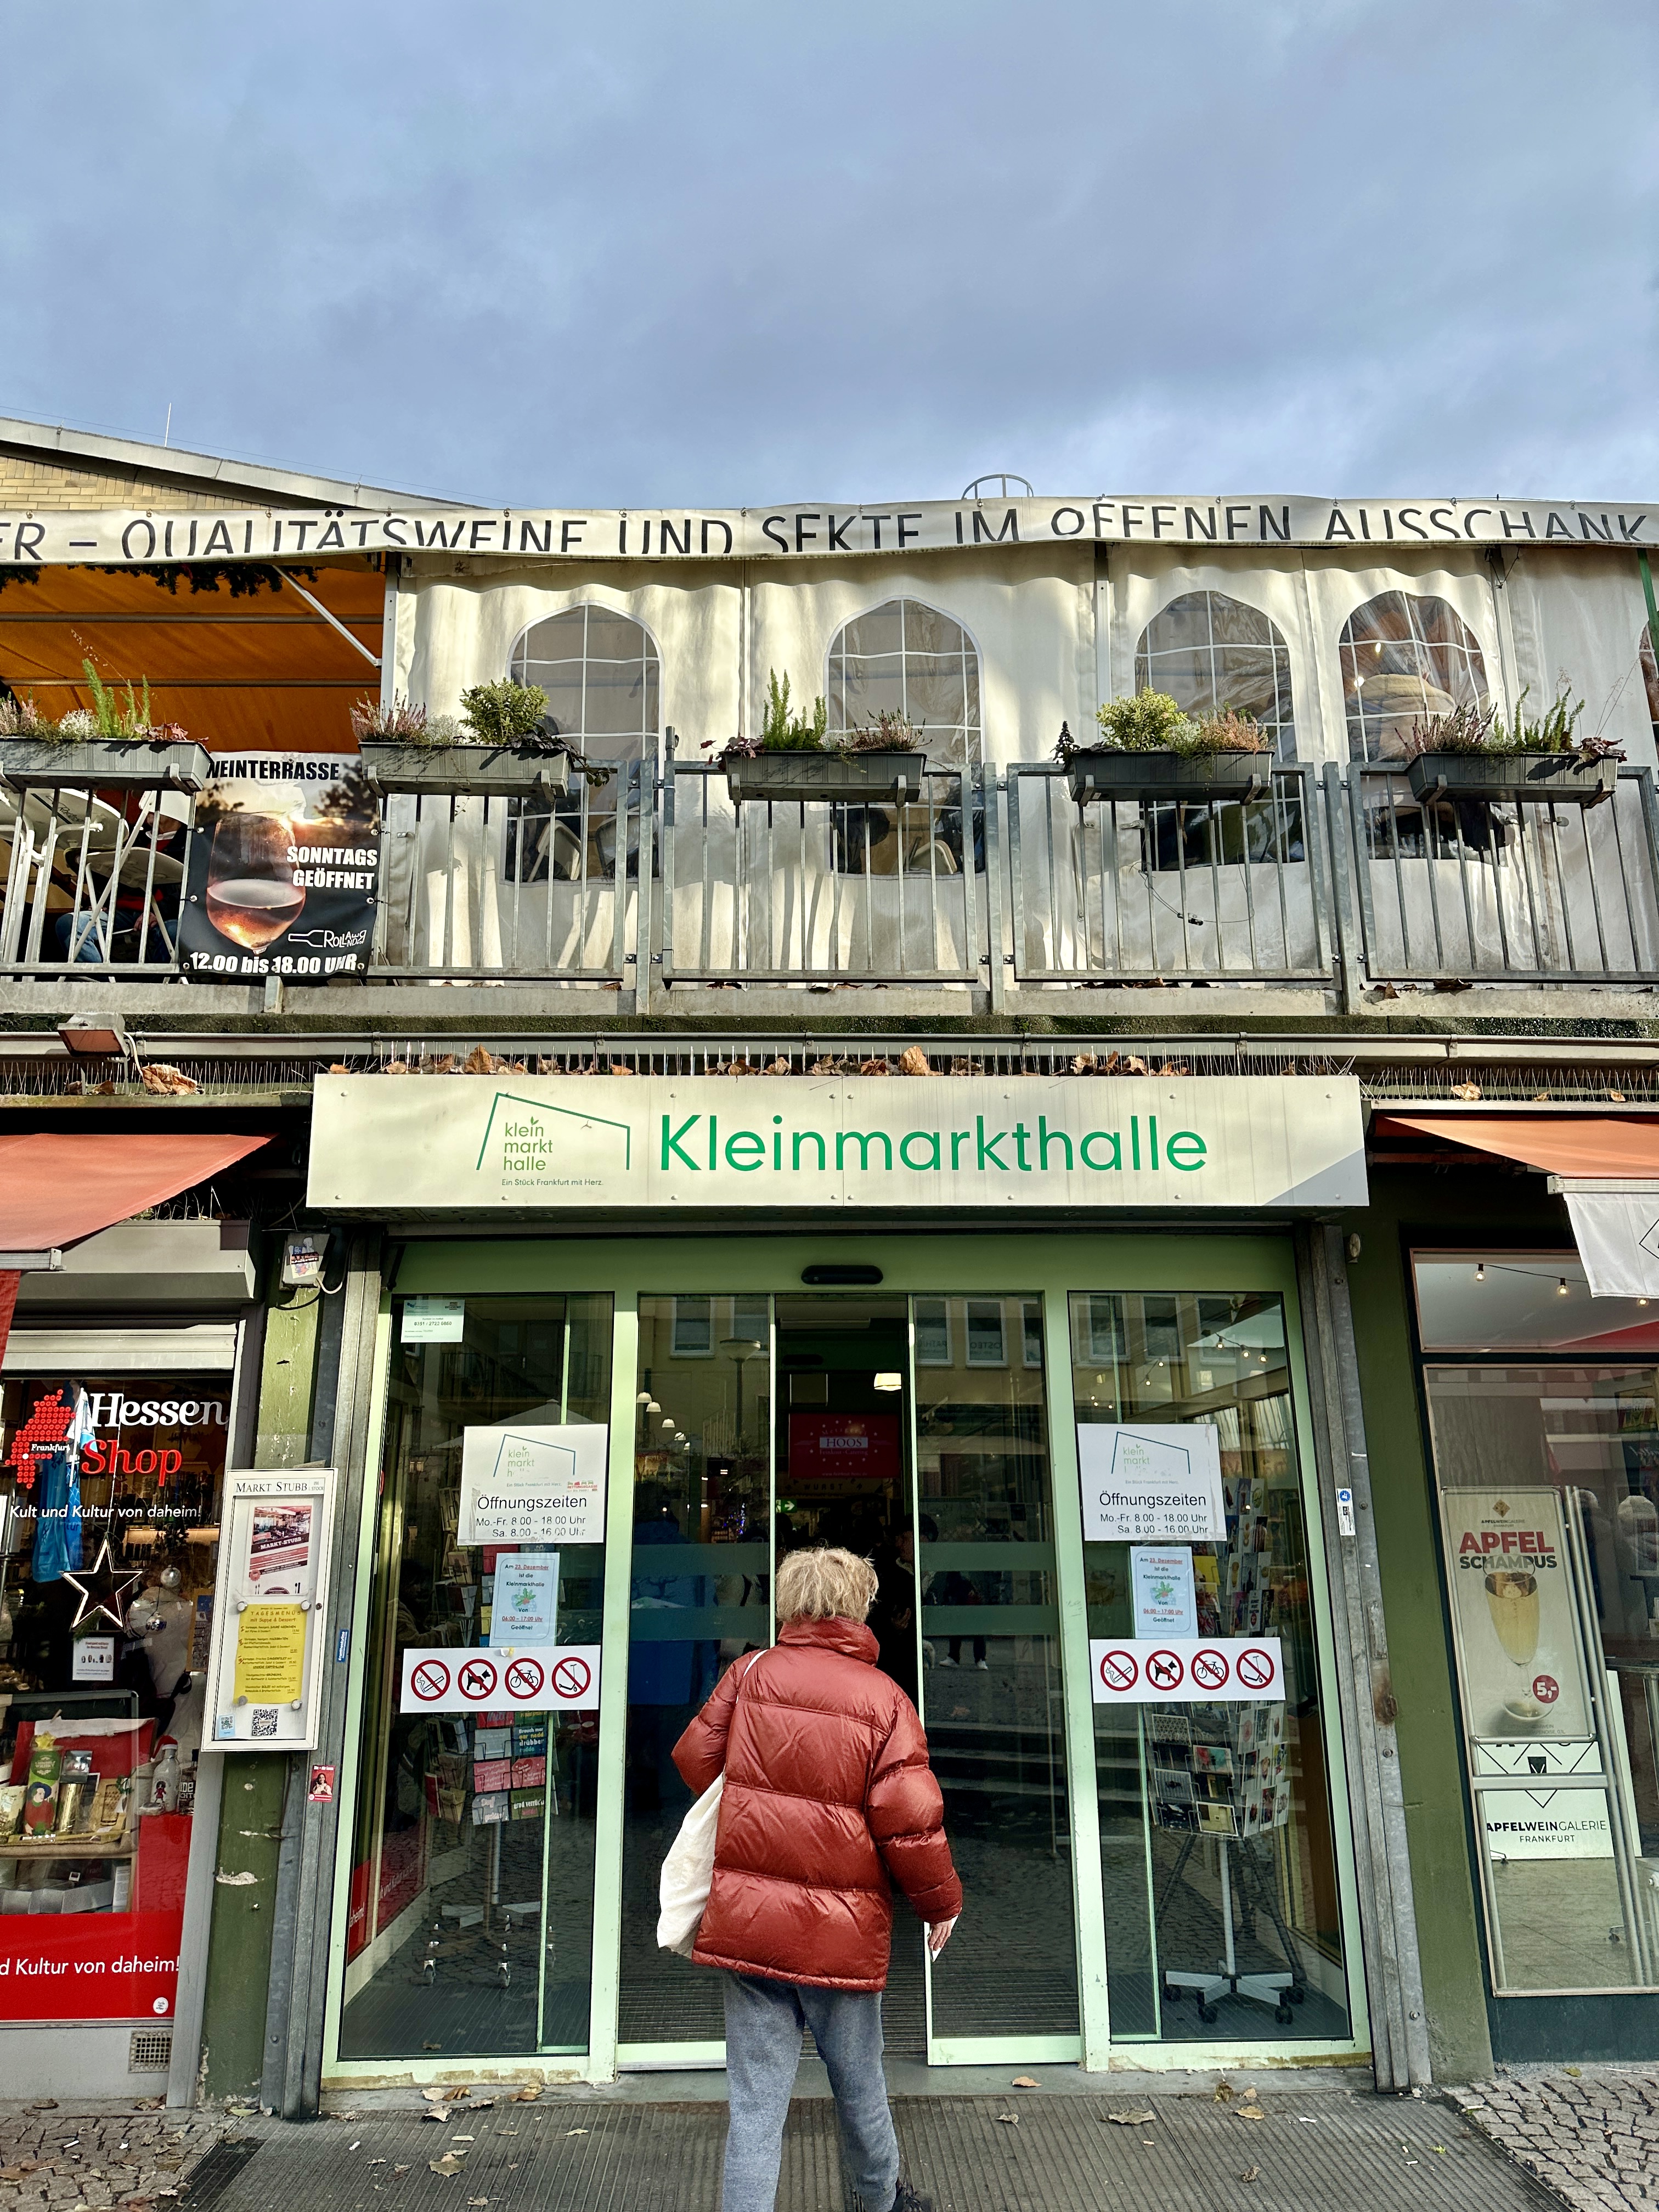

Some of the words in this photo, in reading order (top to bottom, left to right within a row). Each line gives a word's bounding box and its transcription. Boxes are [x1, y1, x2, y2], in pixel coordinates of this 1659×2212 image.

[955, 508, 1020, 544] IM
[286, 845, 378, 867] SONNTAGS
[292, 867, 374, 890] GEÖFFNET
[190, 952, 240, 973] 12.00
[241, 956, 269, 974] bis
[272, 956, 323, 974] 18.00
[325, 953, 357, 974] UHR
[505, 1122, 544, 1137] klein
[504, 1139, 552, 1153] markt
[661, 1114, 1207, 1171] Kleinmarkthalle
[504, 1156, 546, 1171] halle
[90, 1393, 229, 1429] Hessen
[31, 1443, 70, 1452] Frankfurt
[826, 1438, 862, 1447] HOOS
[508, 1449, 530, 1458] klein
[1123, 1447, 1144, 1455] klein
[81, 1440, 182, 1487] Shop
[507, 1459, 535, 1467] markt
[1124, 1457, 1150, 1465] markt
[235, 1483, 272, 1493] MARKT
[276, 1481, 307, 1492] STUBB
[478, 1494, 587, 1511] Öffnungszeiten
[1099, 1490, 1206, 1509] Öffnungszeiten
[10, 1505, 38, 1518] Kult
[42, 1505, 69, 1518] und
[72, 1505, 115, 1517] Kultur
[118, 1509, 143, 1517] von
[147, 1505, 202, 1517] daheim!
[1101, 1514, 1132, 1522] Mo.-Fr.
[1135, 1514, 1154, 1522] 8.00
[1164, 1514, 1188, 1522] 18.00
[1191, 1514, 1207, 1522] Uhr
[476, 1517, 508, 1526] Mo.-Fr.
[569, 1516, 586, 1524] Uhr
[493, 1529, 507, 1537] Sa.
[511, 1528, 531, 1537] 8.00
[1118, 1525, 1132, 1534] Sa.
[1192, 1525, 1208, 1534] Uhr
[1459, 1531, 1555, 1554] APFEL
[1459, 1555, 1558, 1570] SCHAMPUS
[1487, 1820, 1607, 1832] APFELWEINGALERIE
[15, 1957, 69, 1975] Kultur
[74, 1961, 105, 1973] von
[111, 1955, 180, 1973] daheim!
